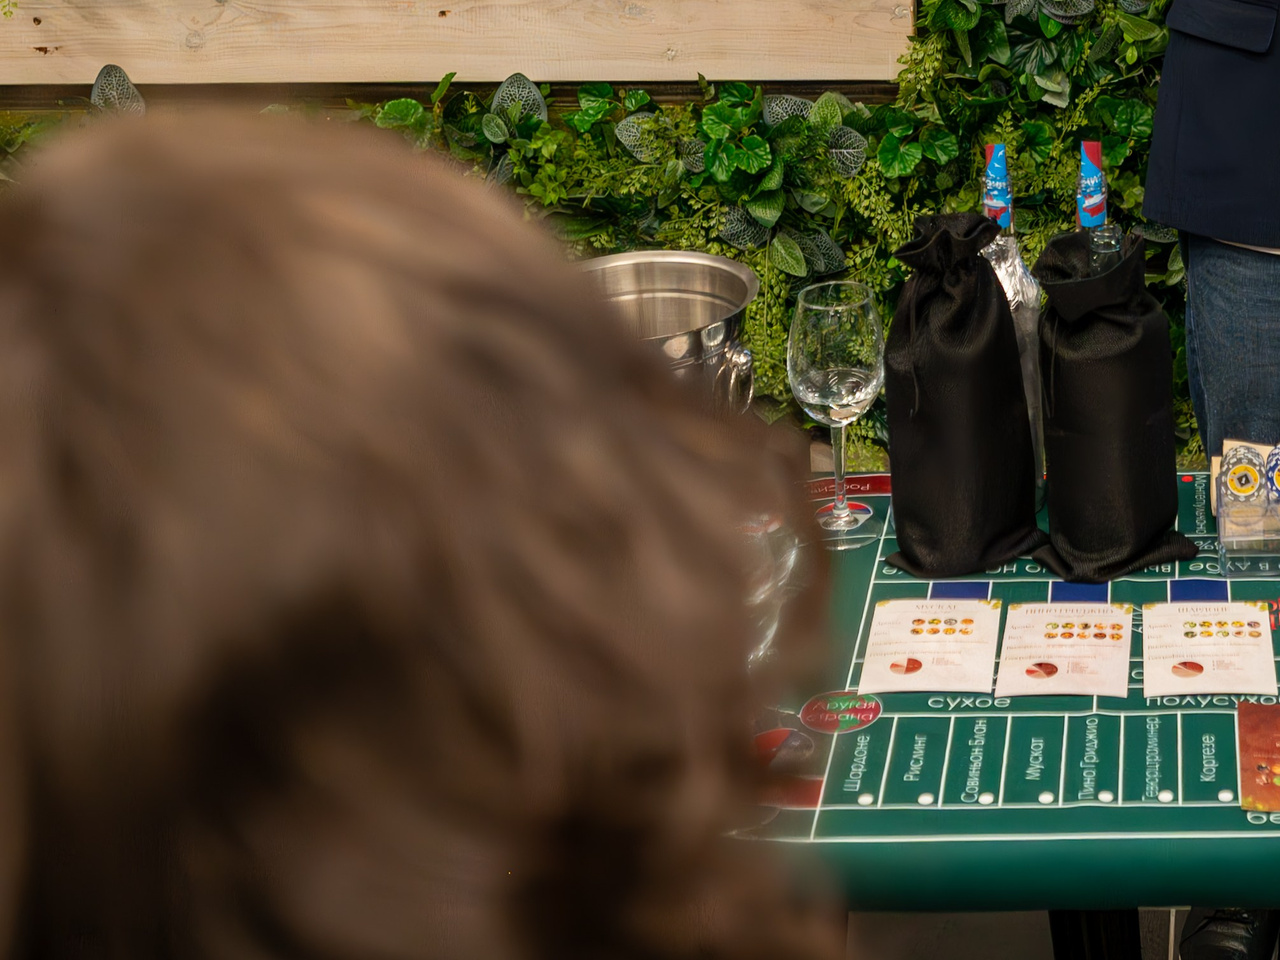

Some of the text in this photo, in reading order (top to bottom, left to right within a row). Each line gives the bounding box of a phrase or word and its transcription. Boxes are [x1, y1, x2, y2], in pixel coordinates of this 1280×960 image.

[927, 695, 1012, 711] сухое
[843, 733, 871, 792] Шардоне
[903, 733, 927, 782] Рислинг
[960, 719, 988, 803] Совиньон Блан
[1024, 737, 1044, 781] Мускат
[1078, 717, 1099, 800] Пино Гриджио
[1200, 733, 1217, 782] Кортезе
